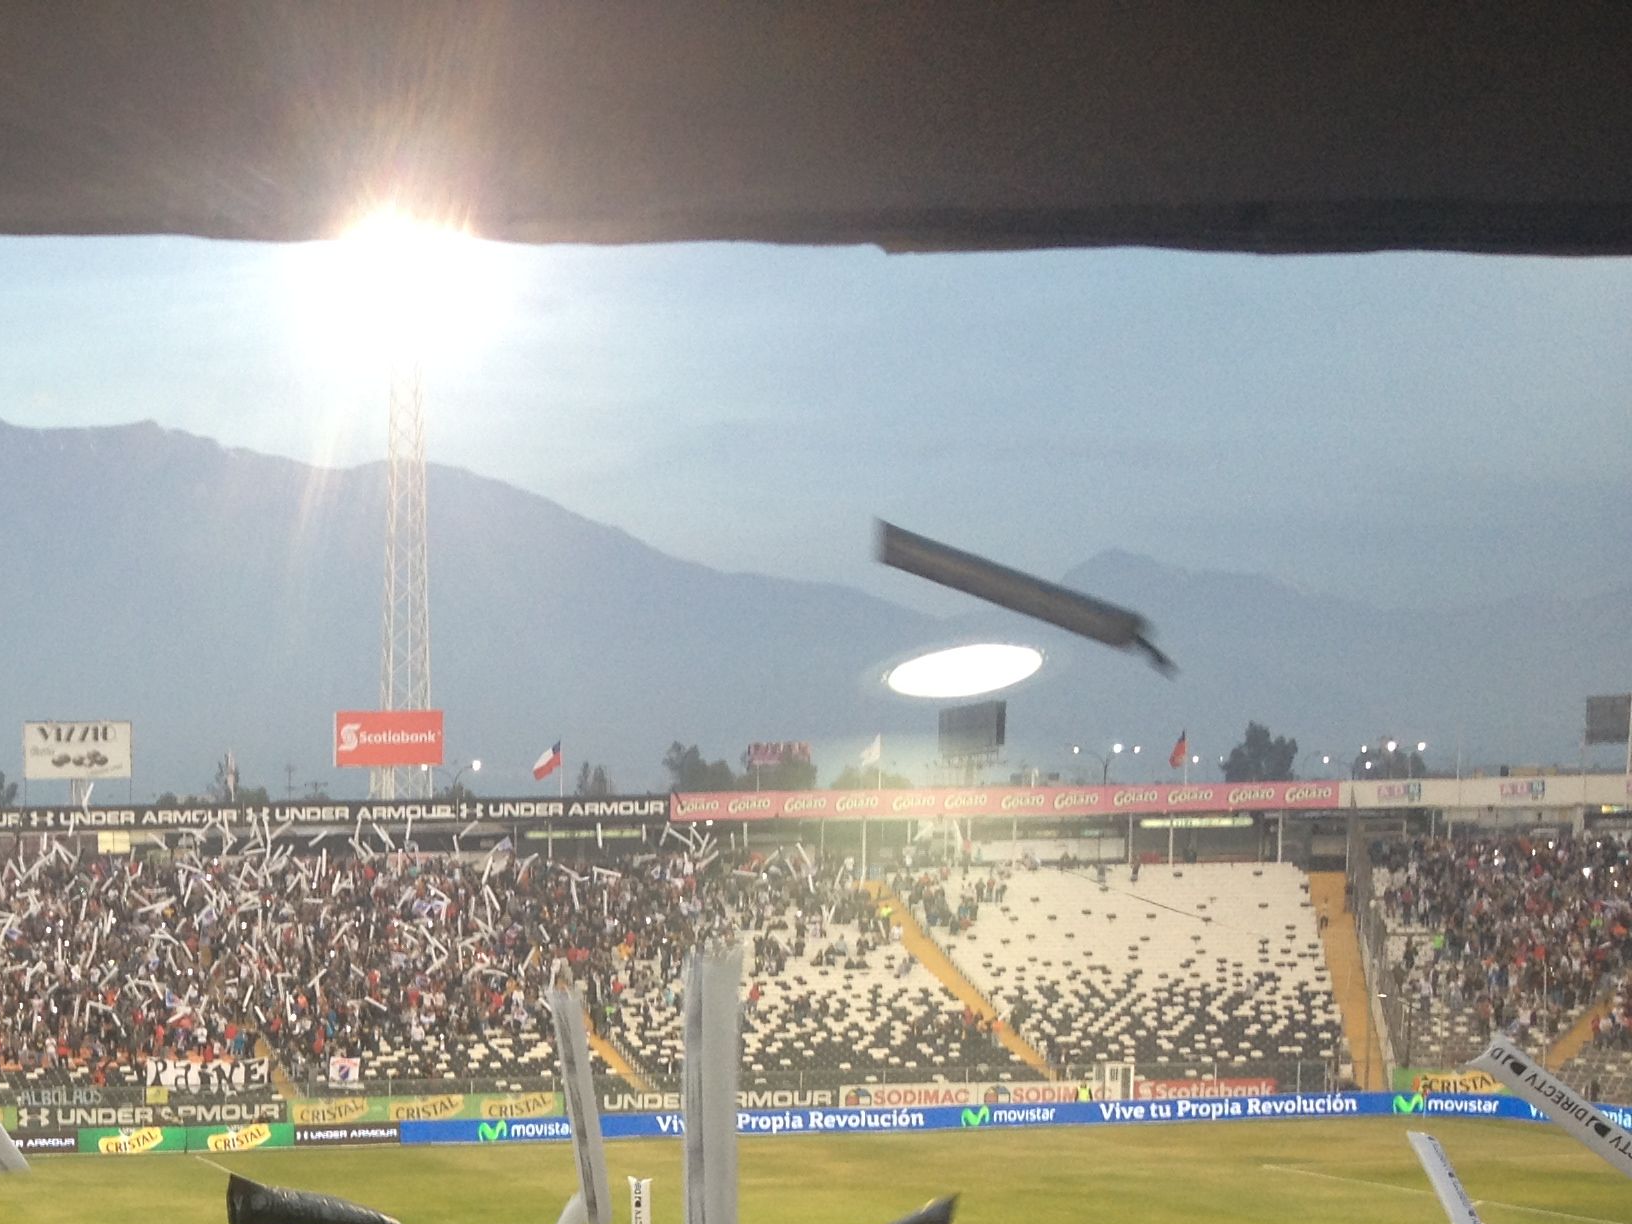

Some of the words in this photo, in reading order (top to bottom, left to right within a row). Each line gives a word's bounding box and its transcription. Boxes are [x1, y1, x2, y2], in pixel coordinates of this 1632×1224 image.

[359, 730, 436, 745] Scotiabank
[60, 812, 135, 827] UNDER
[142, 809, 237, 824] ARMOUR
[275, 806, 349, 822] UNDER
[357, 804, 455, 822] ARMOUR
[488, 802, 563, 818] UNDER
[568, 800, 667, 817] ARMOUR
[604, 1094, 685, 1110] UNDE
[736, 1089, 833, 1108] RMOUR
[874, 1086, 970, 1106] SODIMAC
[1154, 1080, 1274, 1099] Scotiabank
[1525, 1073, 1588, 1121] DIRECTV
[57, 1107, 153, 1125] UNDER
[300, 1099, 366, 1123] CRISTAL
[396, 1096, 460, 1120] CRISTAL
[488, 1094, 552, 1118] CRISTAL
[993, 1107, 1056, 1123] movistar
[1099, 1102, 1145, 1121] Vive
[1150, 1101, 1171, 1119] tu
[1177, 1099, 1242, 1121] Propia
[1247, 1092, 1357, 1115] Revolución
[1428, 1099, 1499, 1113] movistar
[511, 1121, 572, 1137] movista
[737, 1112, 802, 1134] Propia
[808, 1107, 925, 1129] Revolución
[105, 1131, 158, 1153] CRISTAL
[214, 1127, 269, 1151] CRISTAL
